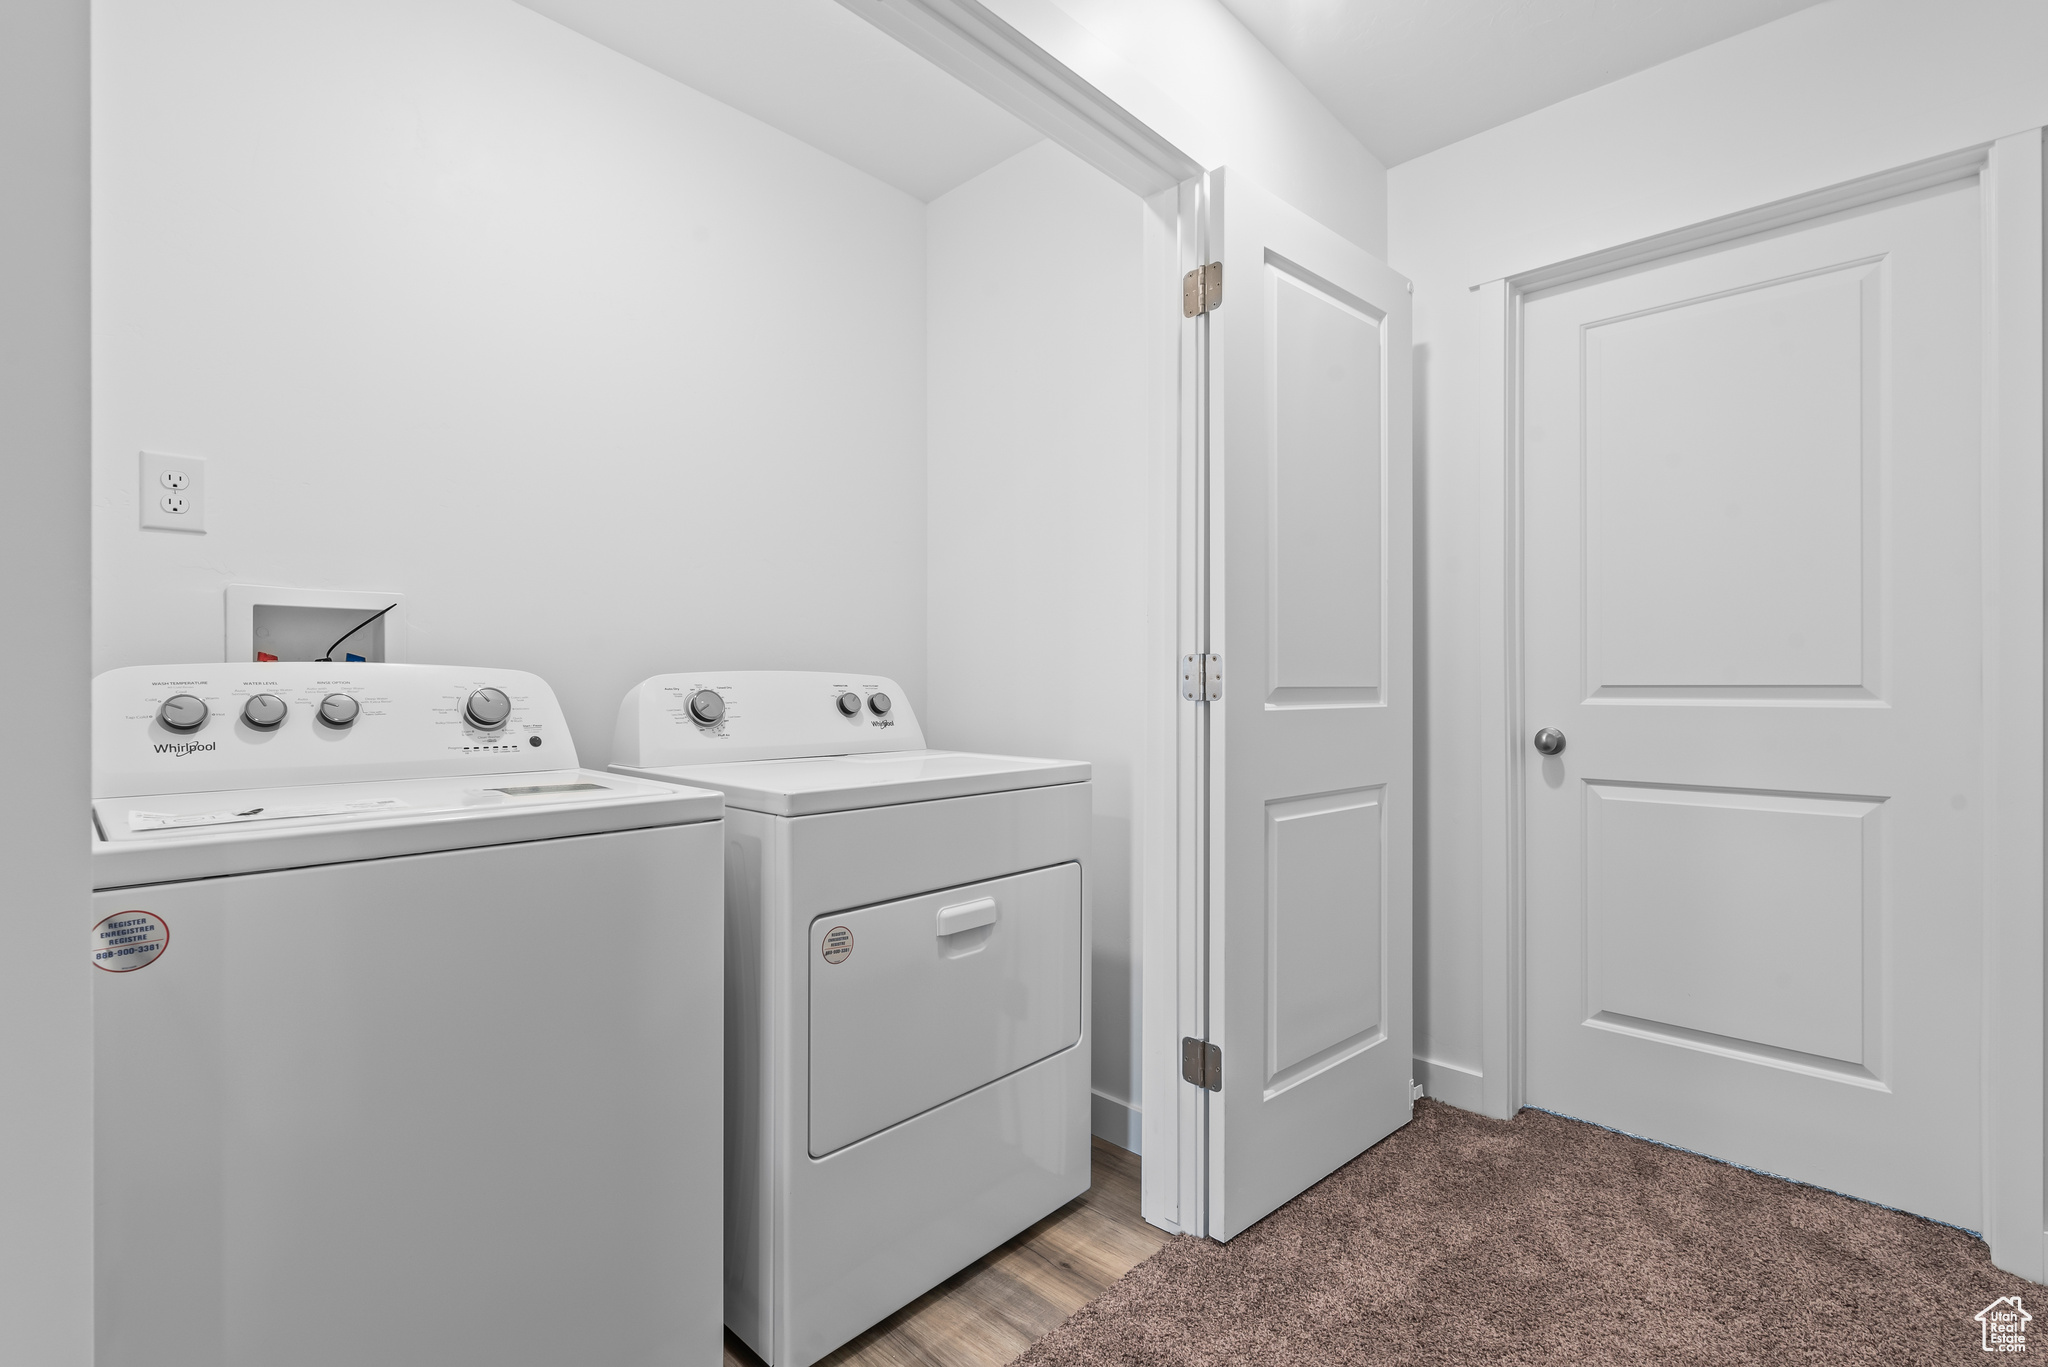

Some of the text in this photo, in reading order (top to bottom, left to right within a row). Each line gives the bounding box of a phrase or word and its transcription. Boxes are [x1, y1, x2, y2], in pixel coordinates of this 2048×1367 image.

[871, 719, 895, 730] Whirlpool
[153, 740, 216, 758] Whirlpool
[108, 918, 147, 929] REGISTER
[100, 924, 155, 939] ENREGISTRER
[108, 934, 148, 946] REGISTRE
[95, 943, 160, 960] 888-900-3381
